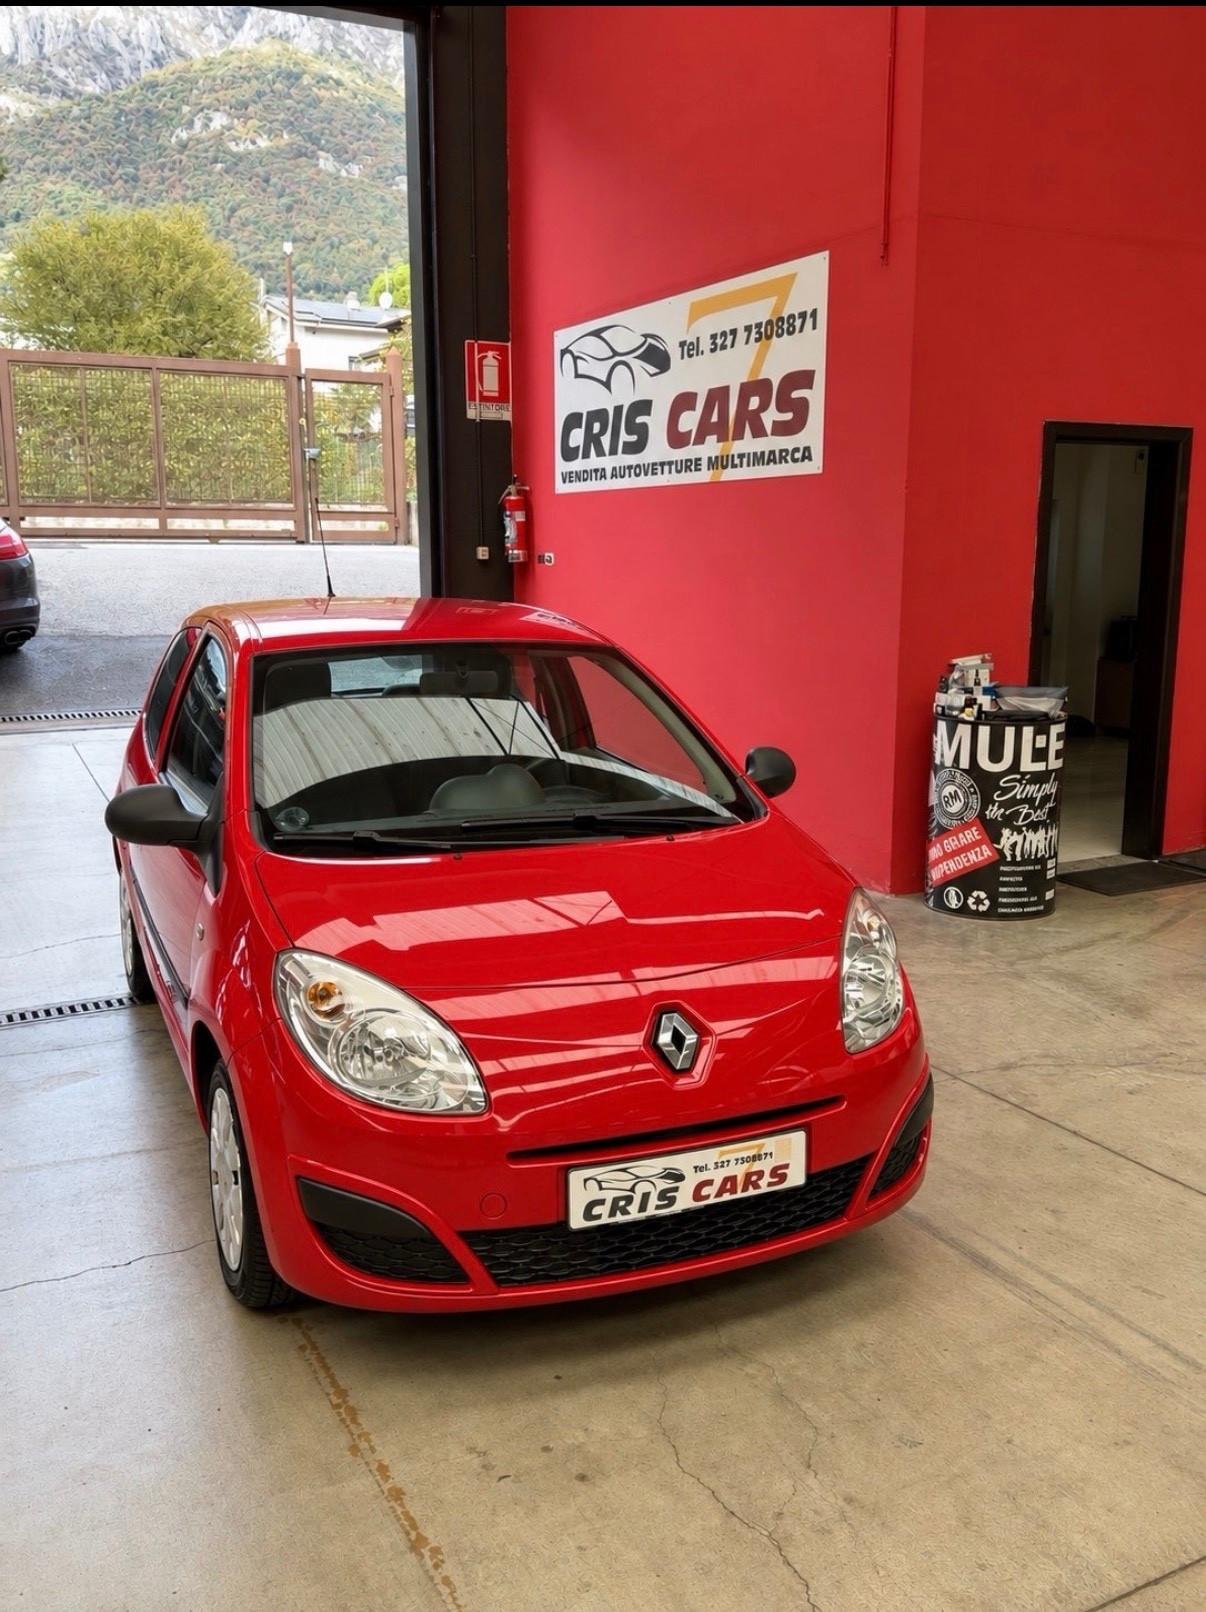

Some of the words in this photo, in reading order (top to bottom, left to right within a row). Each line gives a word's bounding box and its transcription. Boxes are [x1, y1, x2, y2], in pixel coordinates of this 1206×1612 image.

[678, 336, 704, 360] Tel.
[709, 328, 738, 354] 327
[743, 308, 819, 346] 7308871
[560, 399, 653, 462] CRIS
[666, 369, 816, 450] CARS
[561, 467, 608, 485] VENDITA
[610, 456, 703, 480] AUTOVETTURE
[706, 445, 813, 471] MULTIMARCA
[942, 789, 962, 809] RM
[993, 771, 1058, 807] Simply
[985, 802, 1005, 821] the
[1006, 803, 1057, 826] Best
[692, 1163, 711, 1174] Tel.
[582, 1185, 680, 1222] CRIS
[691, 1163, 791, 1203] CARS
